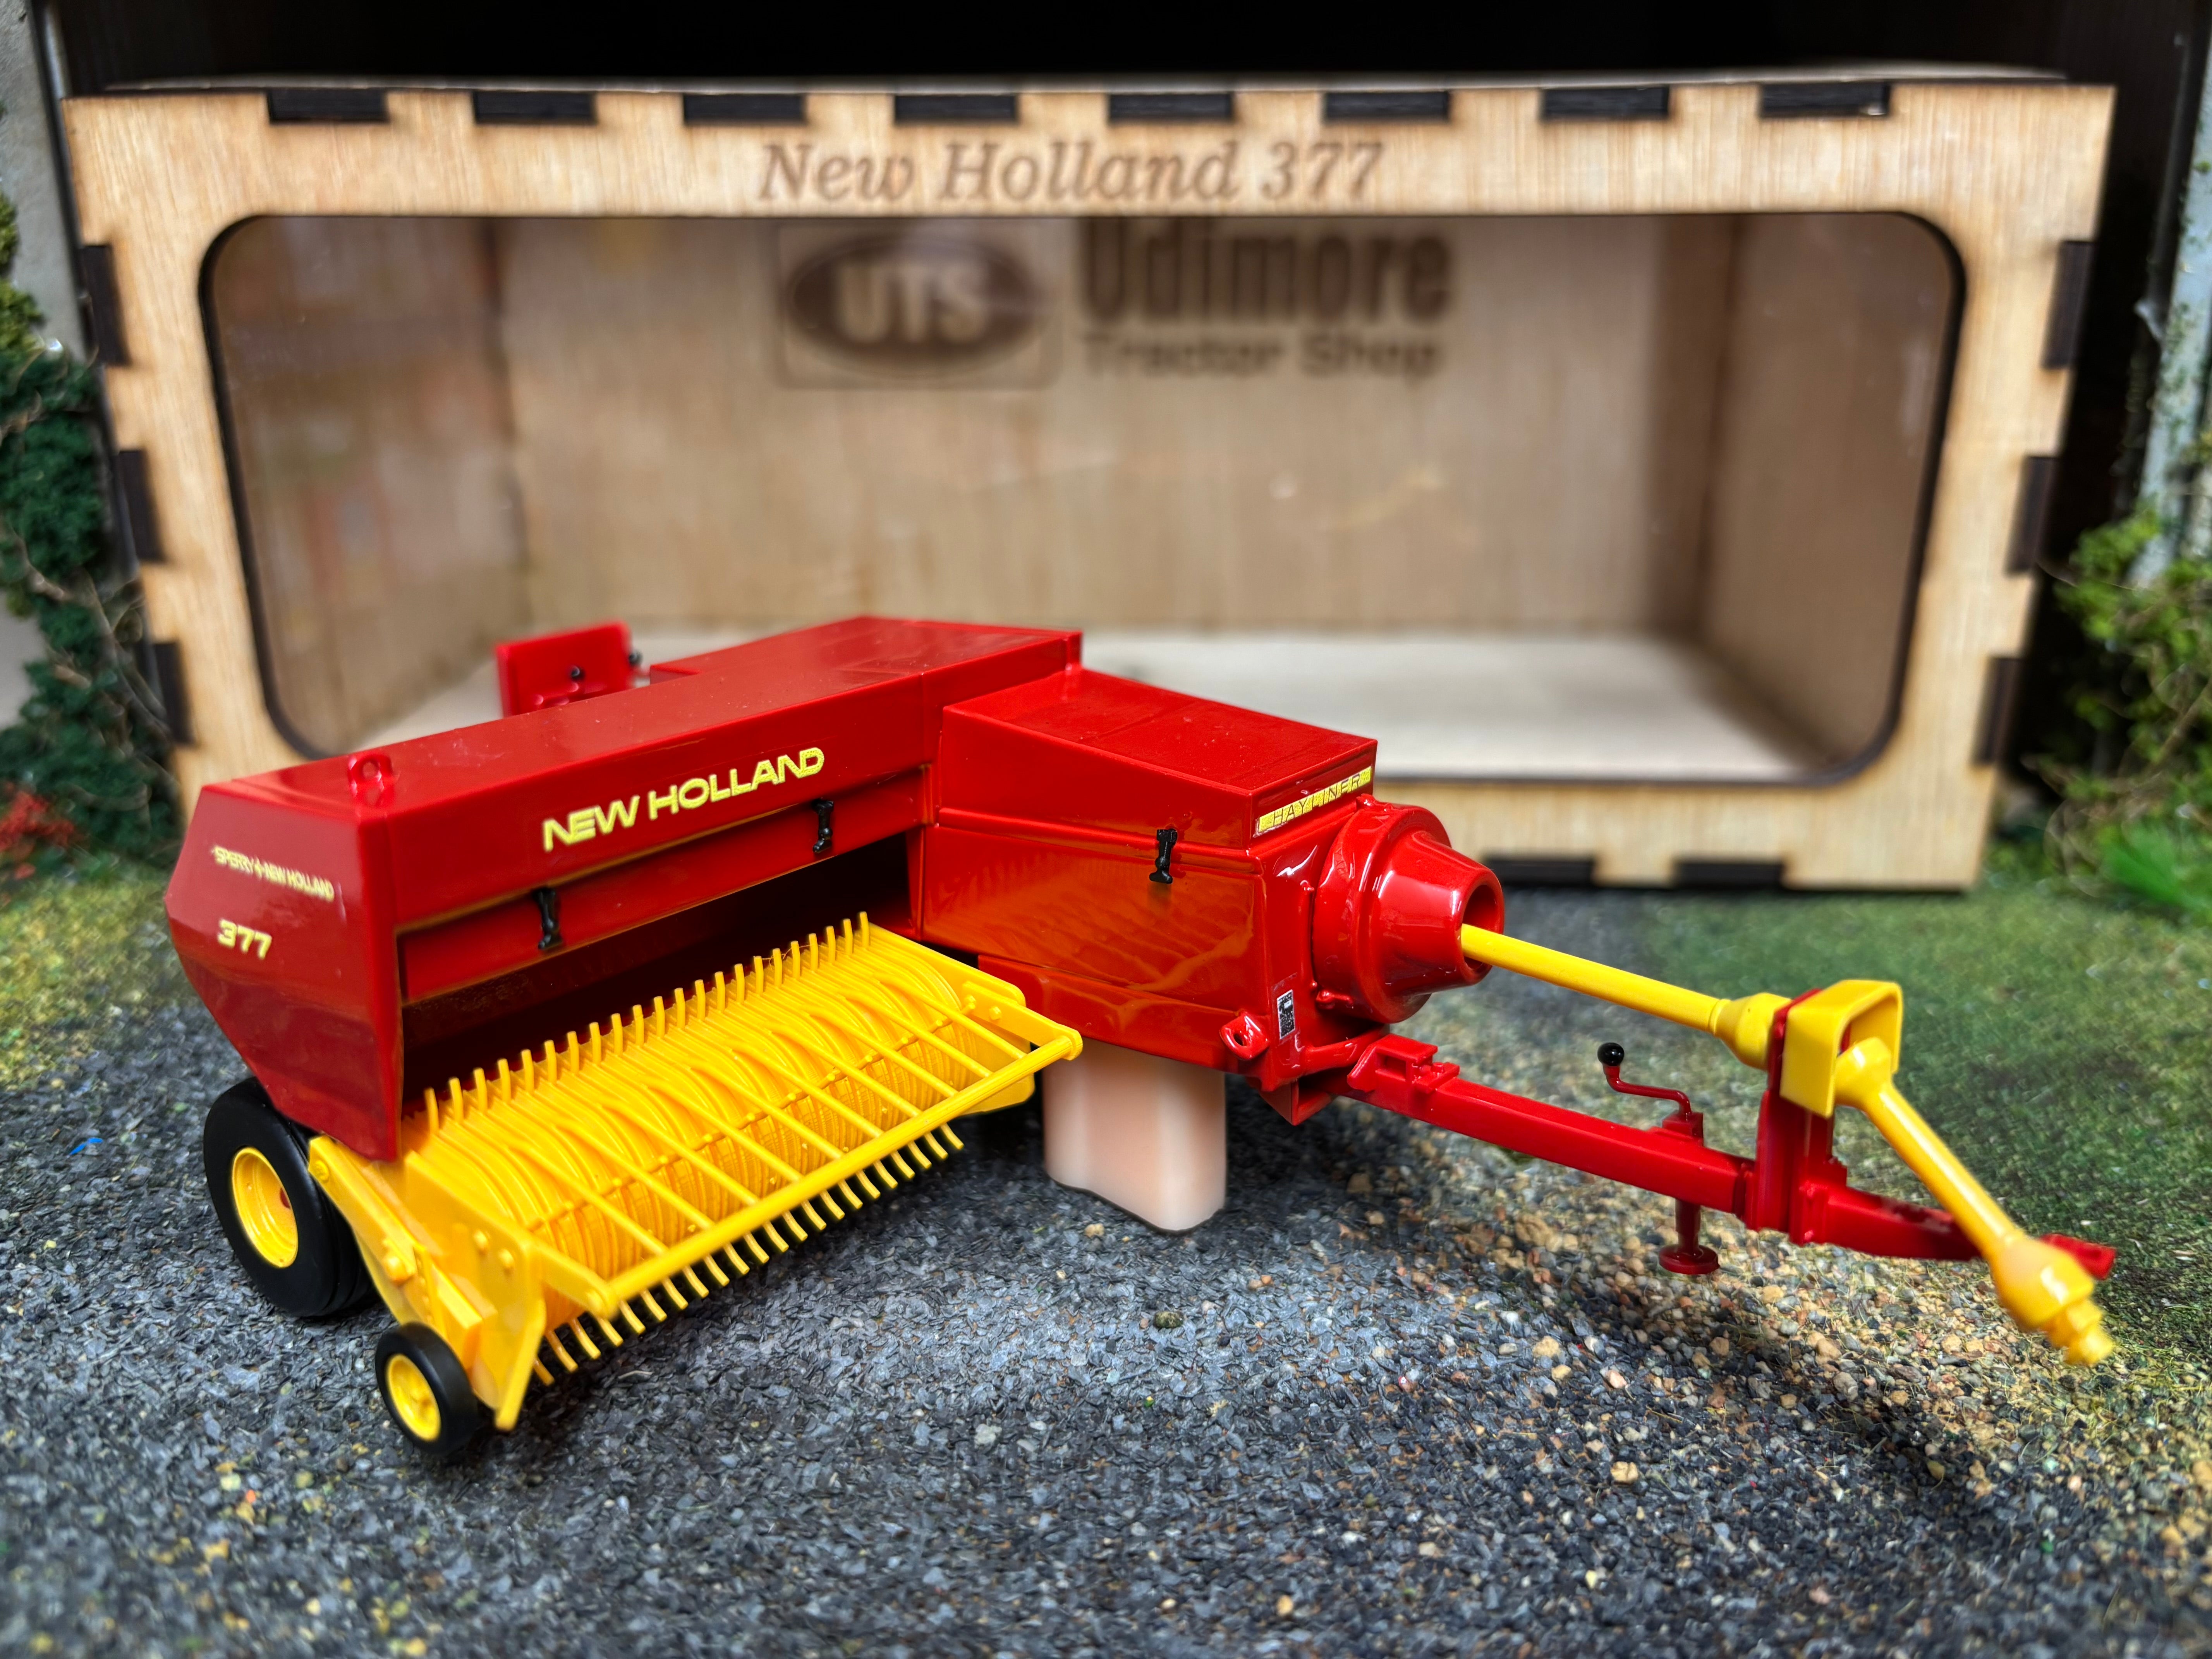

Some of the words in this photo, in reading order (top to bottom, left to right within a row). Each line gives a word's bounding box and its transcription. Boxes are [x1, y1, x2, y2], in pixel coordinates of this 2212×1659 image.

[758, 142, 915, 201] New
[938, 139, 1240, 201] Holland
[1261, 140, 1384, 201] 377
[1079, 216, 1454, 323] Udimore
[835, 260, 991, 345] UTS
[1083, 332, 1288, 379] Tractor
[1300, 329, 1441, 390] Shop
[543, 795, 640, 852] NEW
[647, 747, 825, 821] HOLLAND
[212, 845, 254, 876] SPERRY
[263, 860, 287, 886] NEW
[287, 867, 335, 903] HOLLAND
[217, 918, 272, 960] 377
